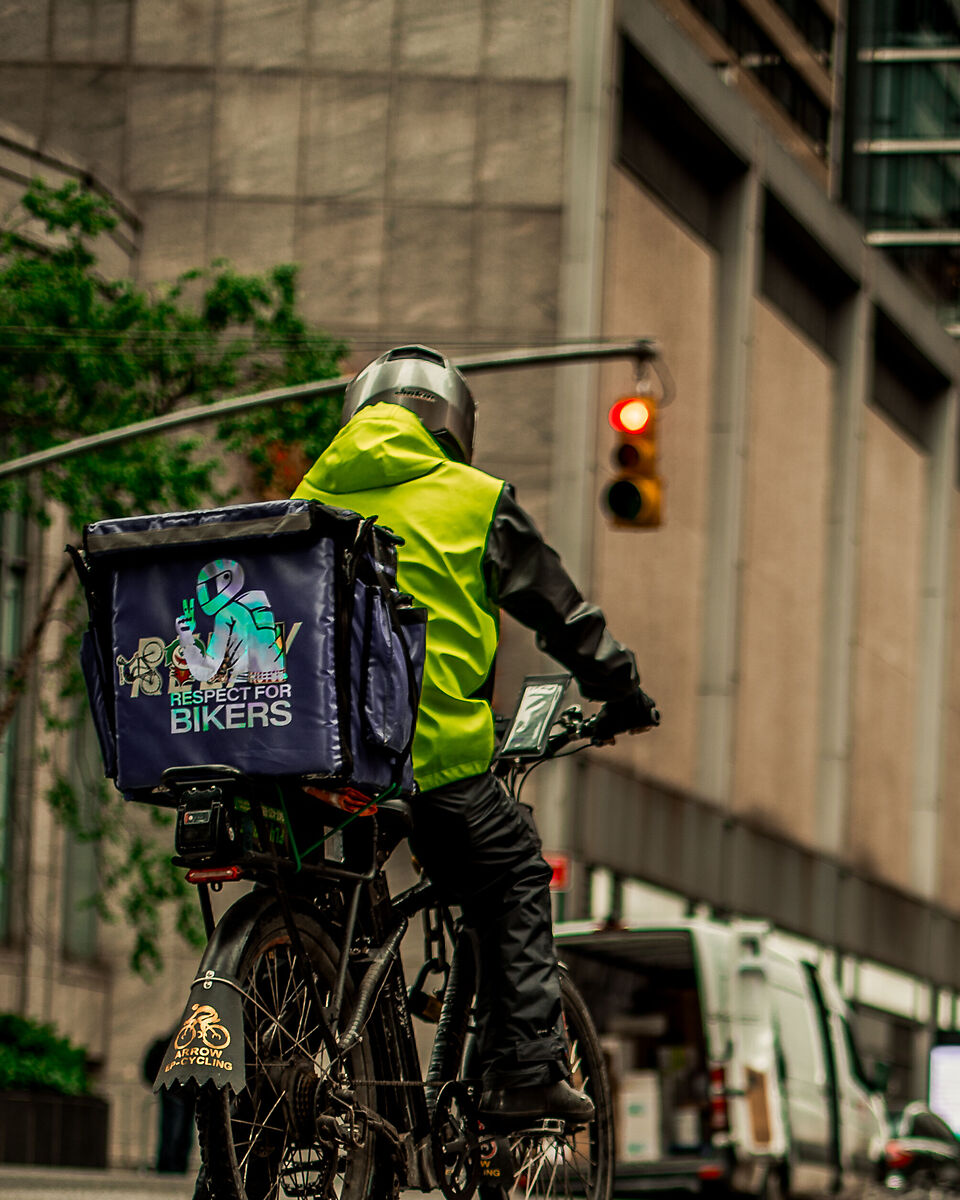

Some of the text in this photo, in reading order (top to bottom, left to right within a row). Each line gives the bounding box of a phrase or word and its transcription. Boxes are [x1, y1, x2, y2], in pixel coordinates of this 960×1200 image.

[170, 683, 292, 706] RESPECT FOR
[170, 700, 293, 734] BIKERS
[174, 1047, 223, 1060] ARROW
